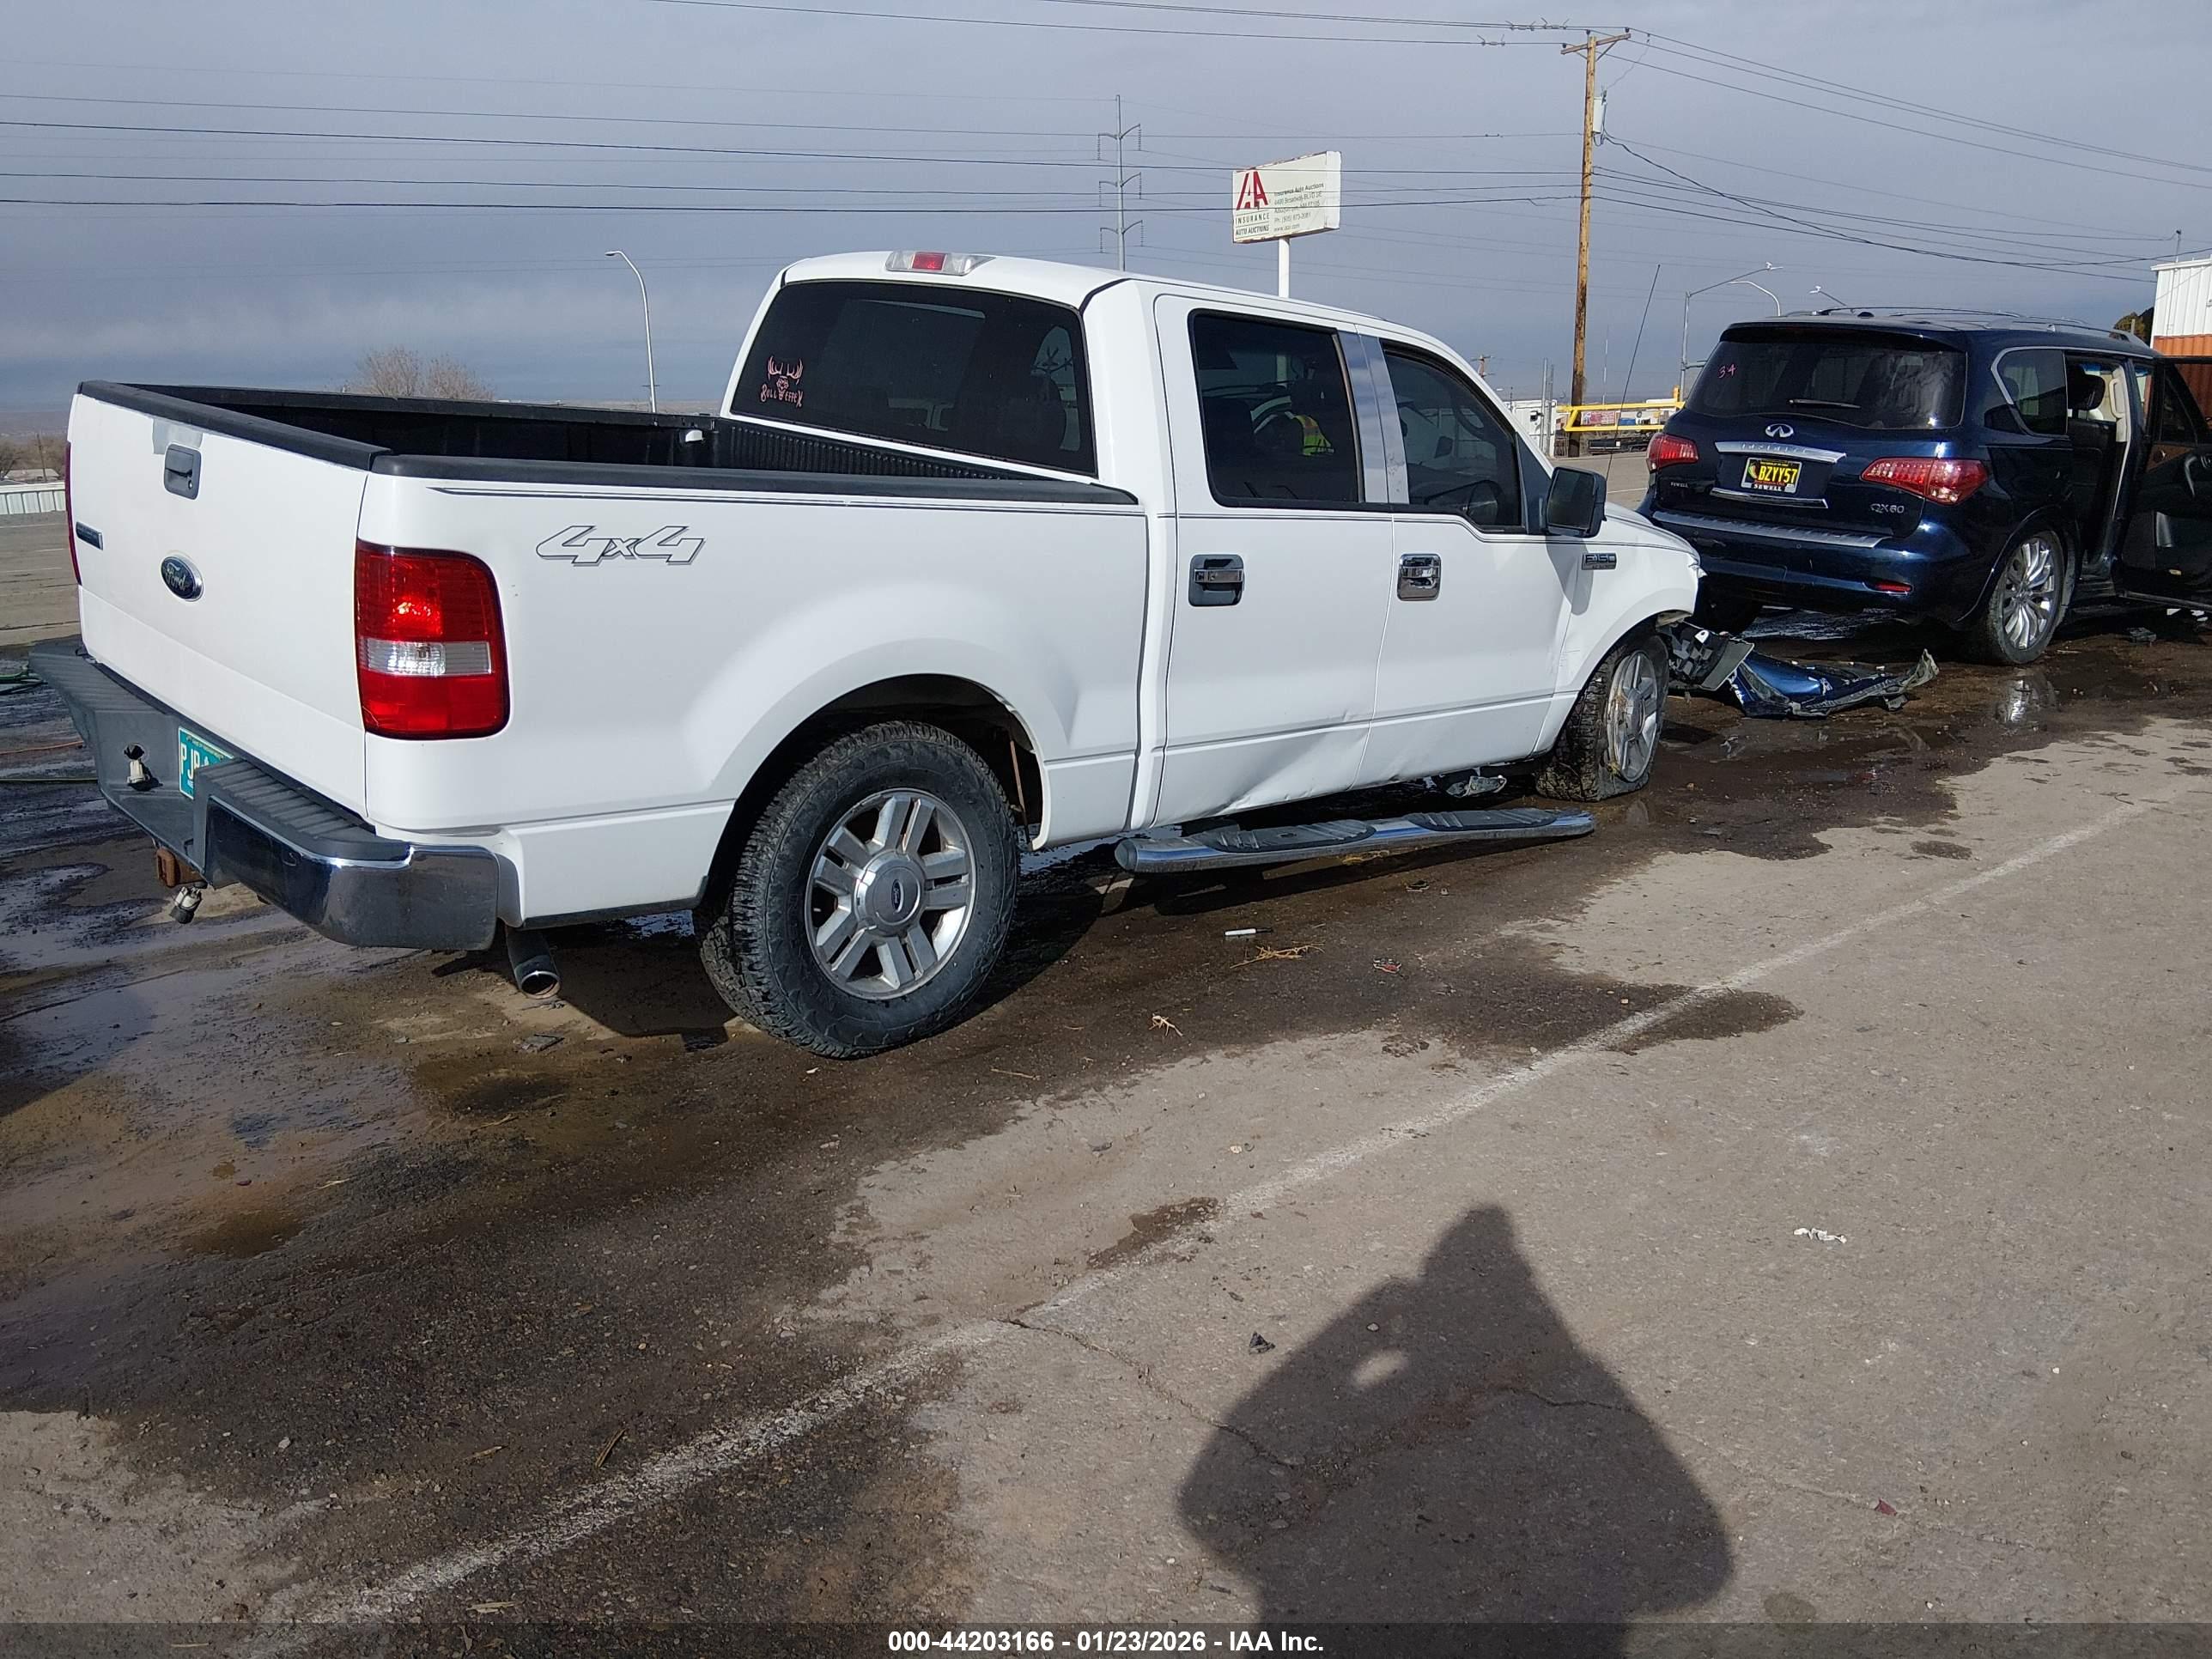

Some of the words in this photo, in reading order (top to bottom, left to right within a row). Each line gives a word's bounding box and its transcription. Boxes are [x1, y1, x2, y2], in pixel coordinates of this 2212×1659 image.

[1236, 212, 1269, 225] INSURANCE
[1248, 225, 1269, 235] AUCTIONS
[1758, 465, 1798, 483] BZYY57
[1753, 483, 1783, 492] SEWELL
